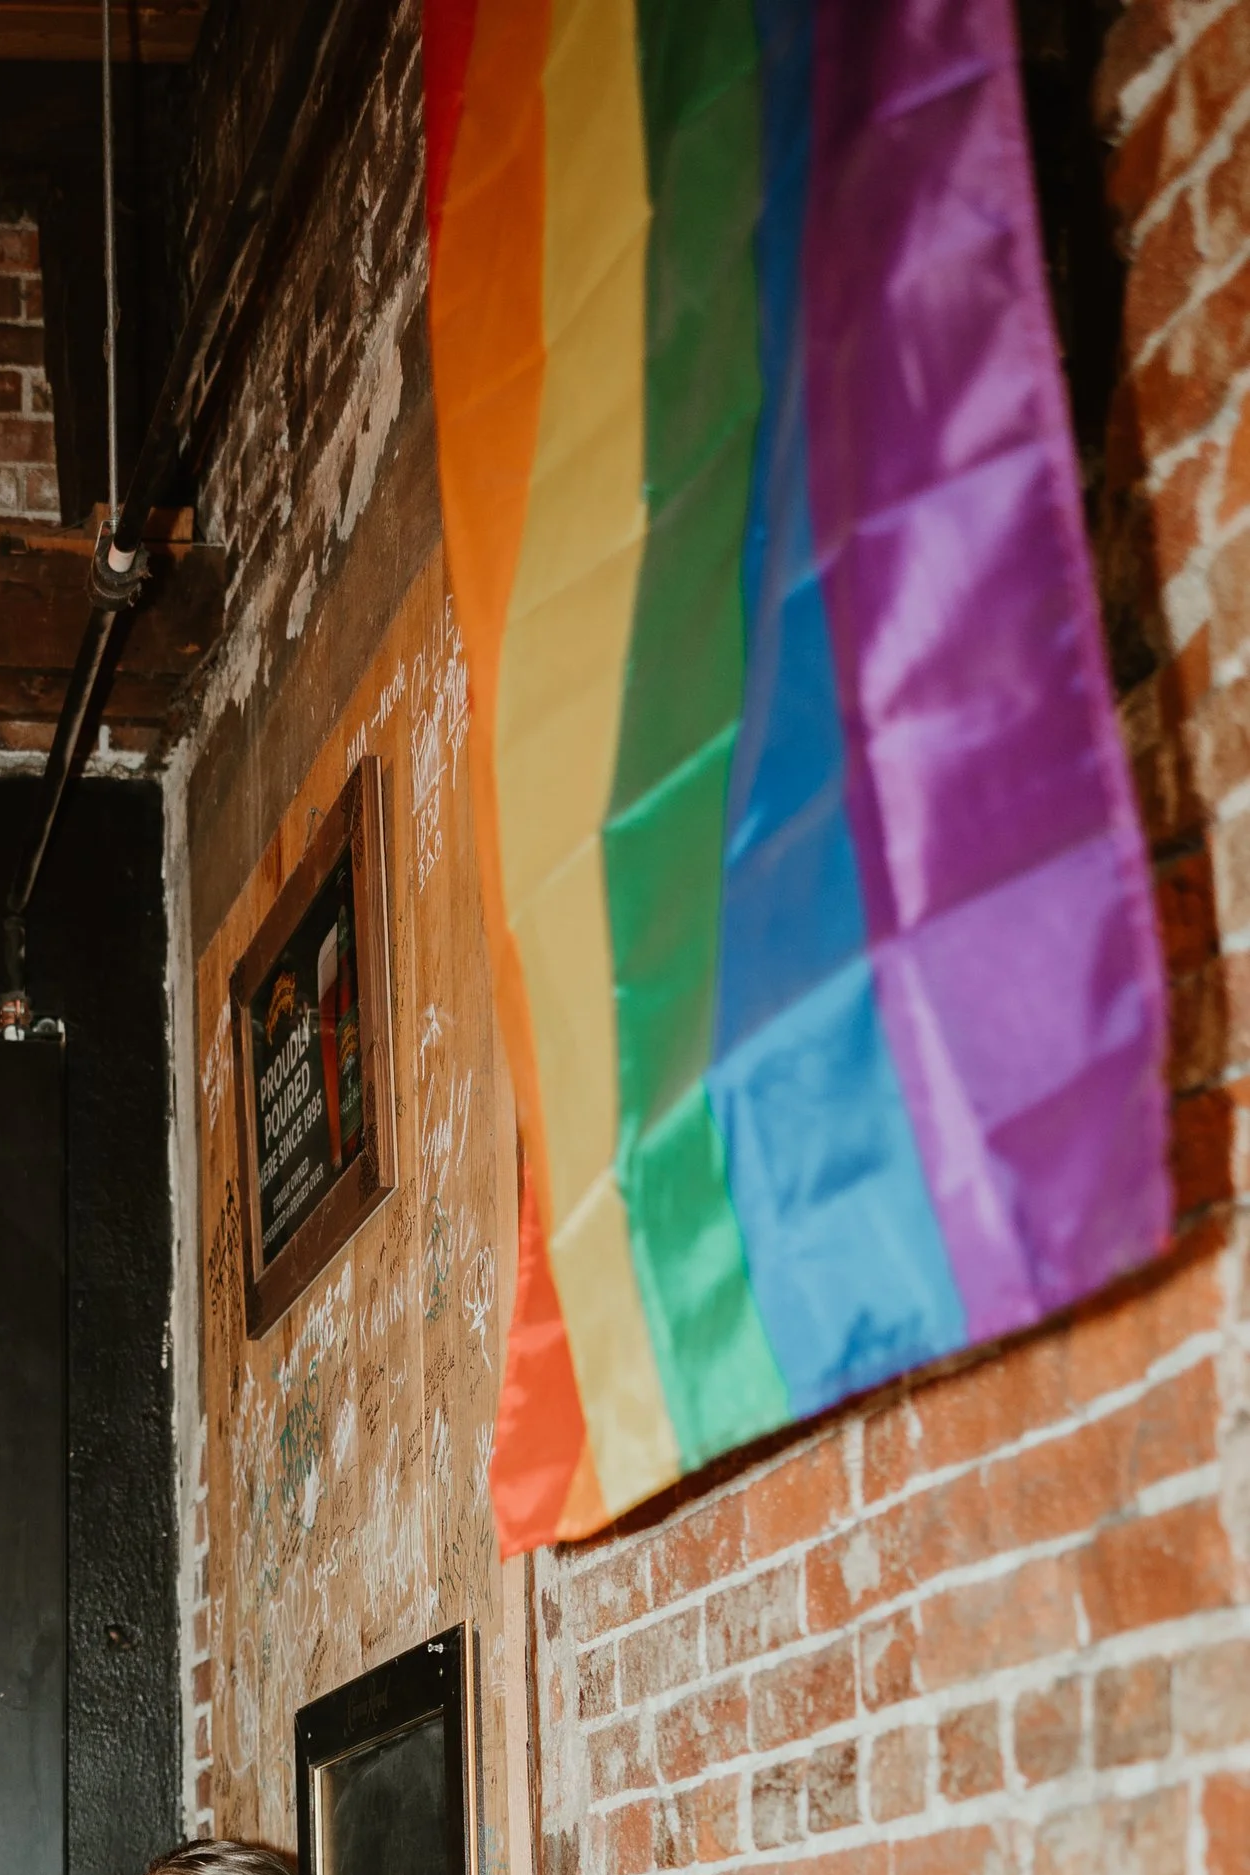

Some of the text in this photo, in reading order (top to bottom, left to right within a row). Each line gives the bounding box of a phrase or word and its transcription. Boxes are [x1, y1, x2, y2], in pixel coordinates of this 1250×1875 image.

[260, 1008, 311, 1112] PROUDLY
[264, 1060, 310, 1149] POURED
[259, 1088, 323, 1193] HERE SINCE 1995
